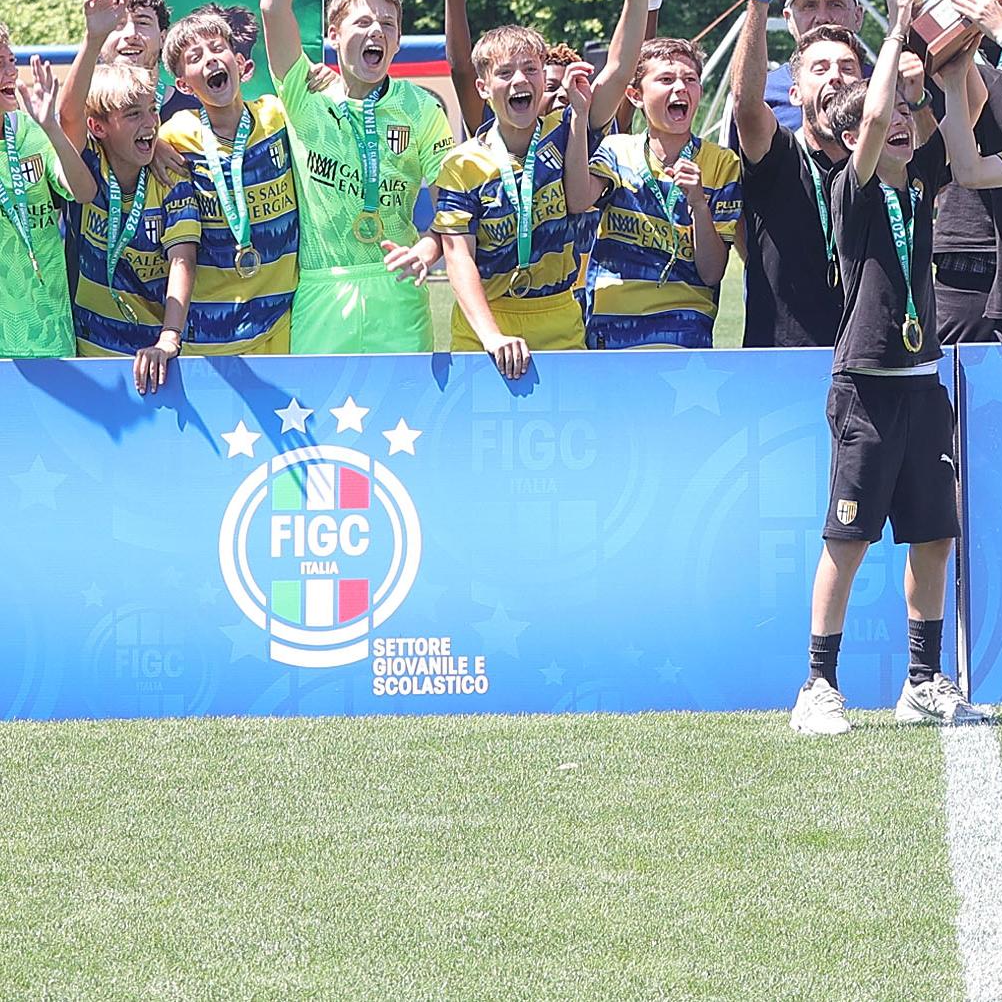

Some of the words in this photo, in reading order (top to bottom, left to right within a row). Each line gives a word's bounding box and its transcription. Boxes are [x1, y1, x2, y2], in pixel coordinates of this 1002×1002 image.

[5, 126, 19, 162] FINALE
[11, 166, 25, 196] 2026
[378, 179, 408, 193] ALES
[126, 201, 142, 231] 2026
[253, 195, 294, 219] ERGIA
[890, 214, 906, 247] 2026
[471, 419, 598, 472] FIGC
[270, 513, 371, 558] FIGC
[299, 561, 340, 575] ITALIA
[372, 637, 451, 657] SETTORE
[372, 656, 468, 676] GIOVANILE
[474, 655, 486, 674] E
[372, 675, 489, 696] SCOLASTICO
